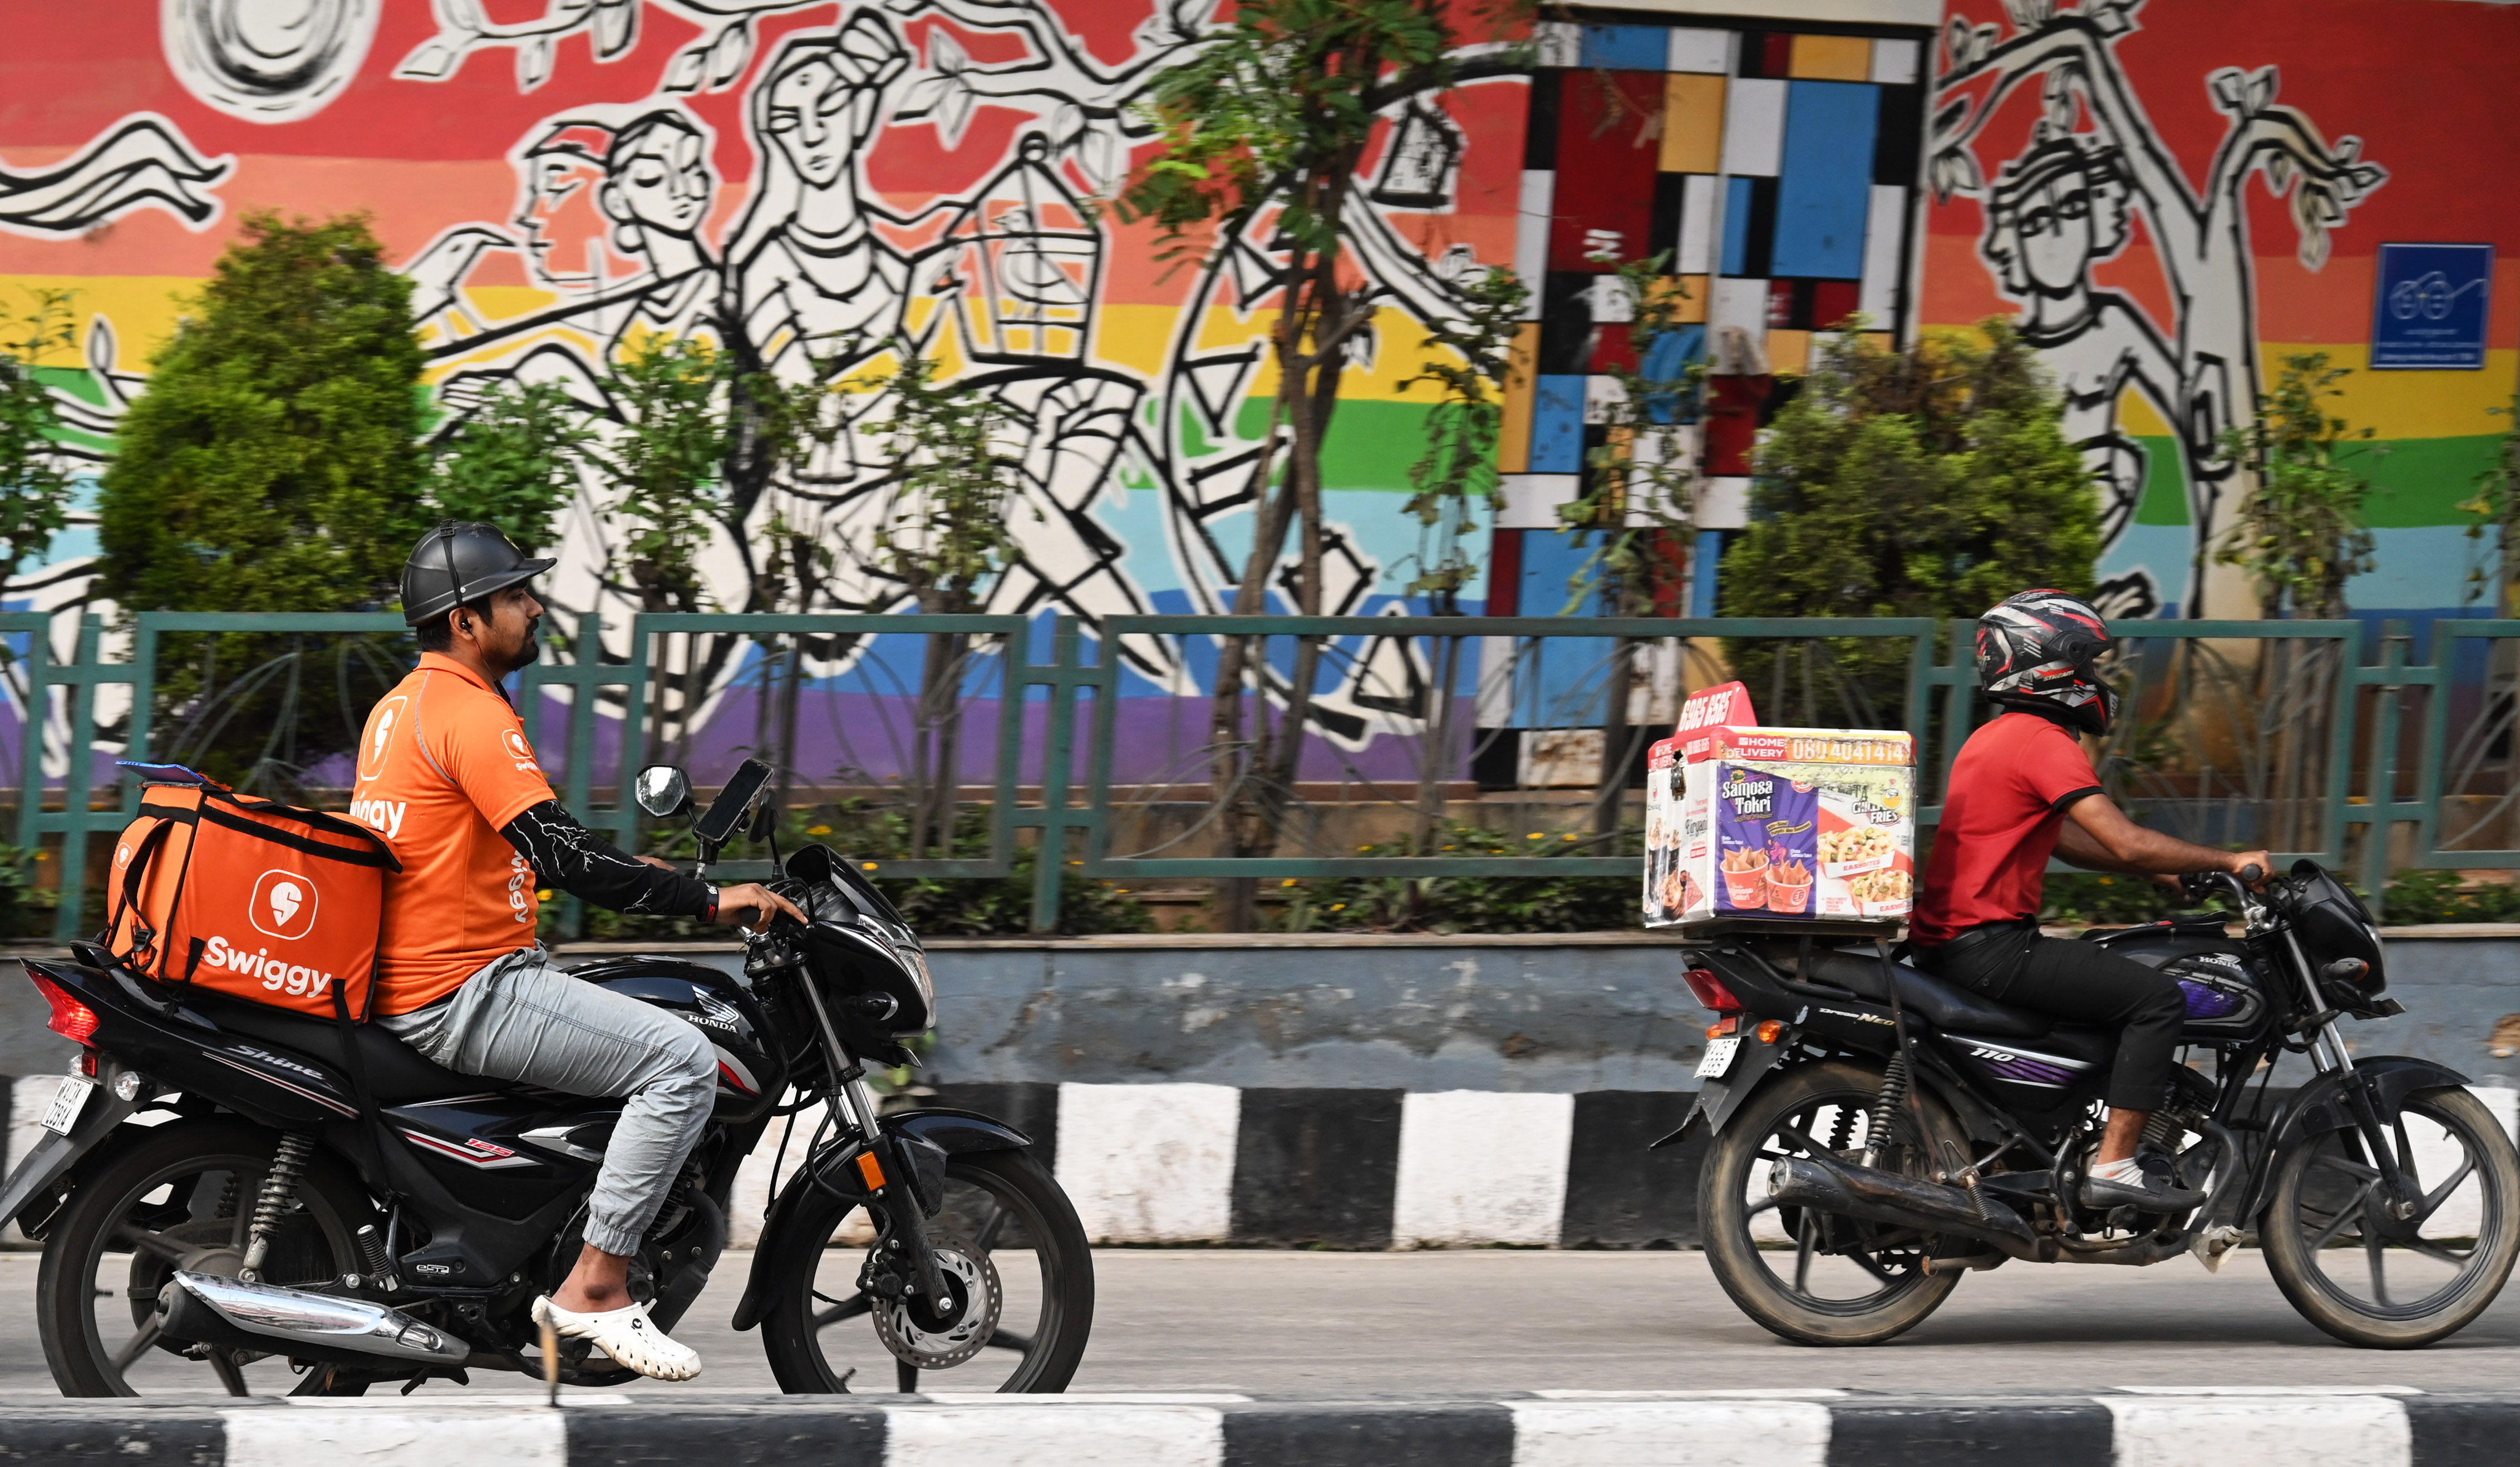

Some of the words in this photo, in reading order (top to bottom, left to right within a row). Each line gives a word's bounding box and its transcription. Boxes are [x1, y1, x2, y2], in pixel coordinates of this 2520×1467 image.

[2044, 670, 2074, 681] STREAM
[1749, 738, 1785, 746] HOME
[1726, 748, 1784, 758] DELIVERY
[1722, 780, 1773, 799] Samosa
[1735, 796, 1771, 815] Tokri
[203, 936, 332, 998] Swiggy
[2199, 956, 2243, 971] HONDA
[1819, 1008, 1859, 1018] Dream
[688, 1015, 738, 1033] HONDA
[228, 1045, 326, 1080] Shine
[1970, 1047, 2015, 1062] 110
[466, 1139, 515, 1157] 125
